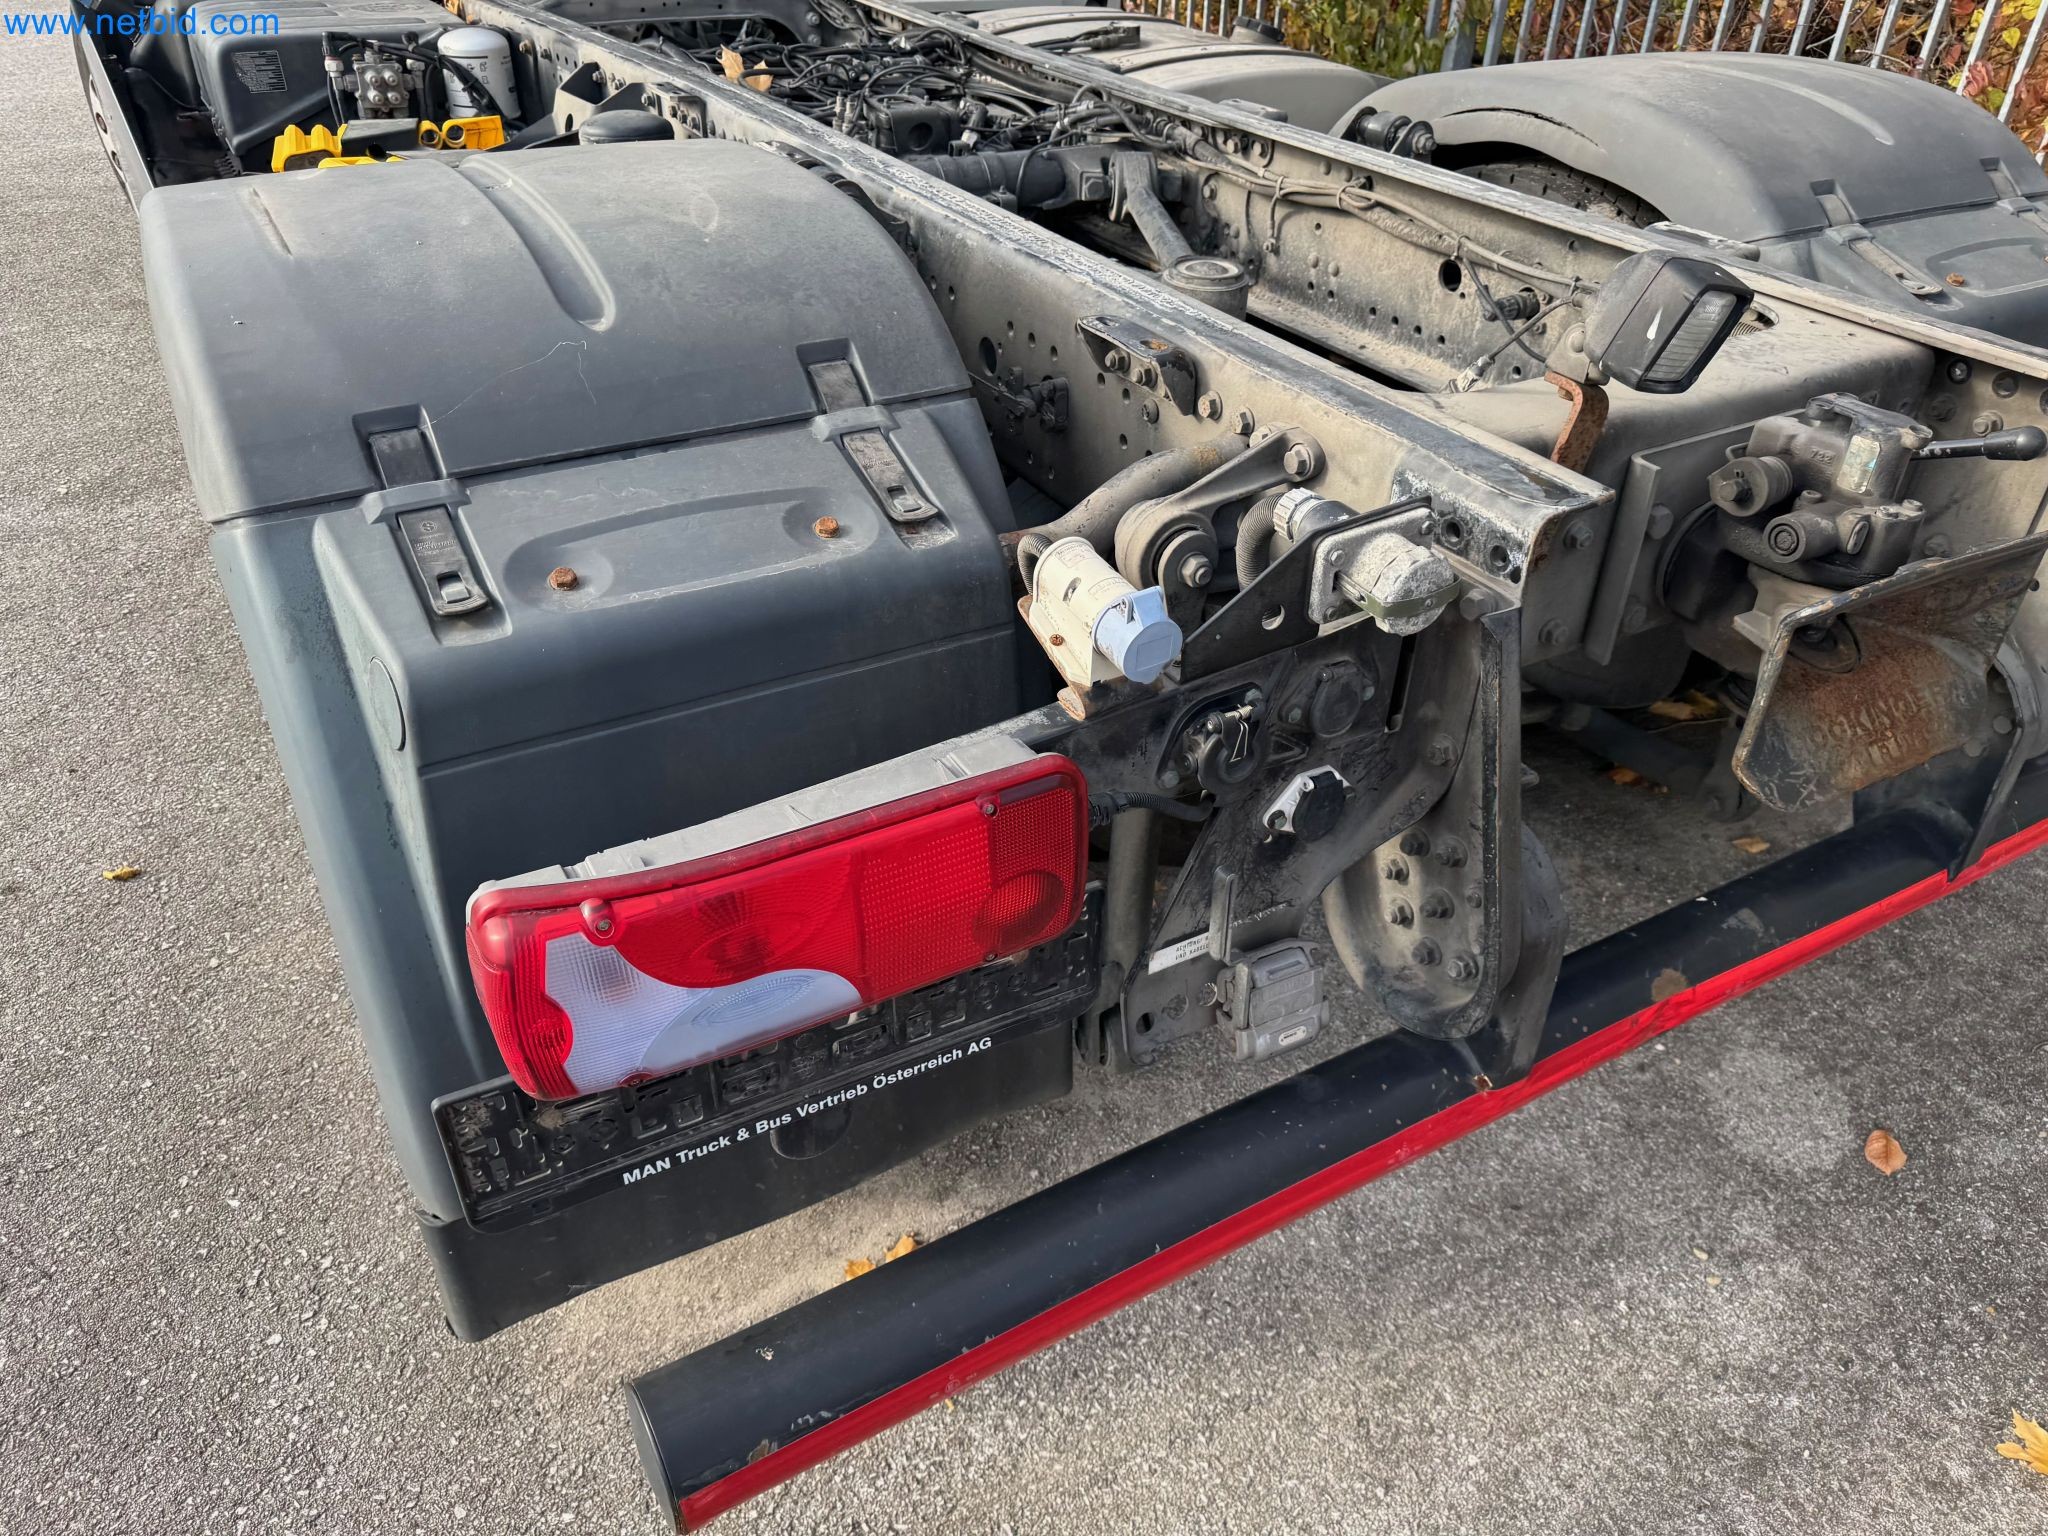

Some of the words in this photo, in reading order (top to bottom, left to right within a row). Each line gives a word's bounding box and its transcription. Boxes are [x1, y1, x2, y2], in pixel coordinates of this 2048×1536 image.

[622, 1157, 671, 1185] MAN
[675, 1135, 732, 1164] Truck
[736, 1127, 750, 1142] &
[755, 1113, 792, 1135] Bus
[796, 1084, 868, 1118] Vertrieb
[872, 1048, 963, 1089] Österreich
[967, 1036, 992, 1055] AG
